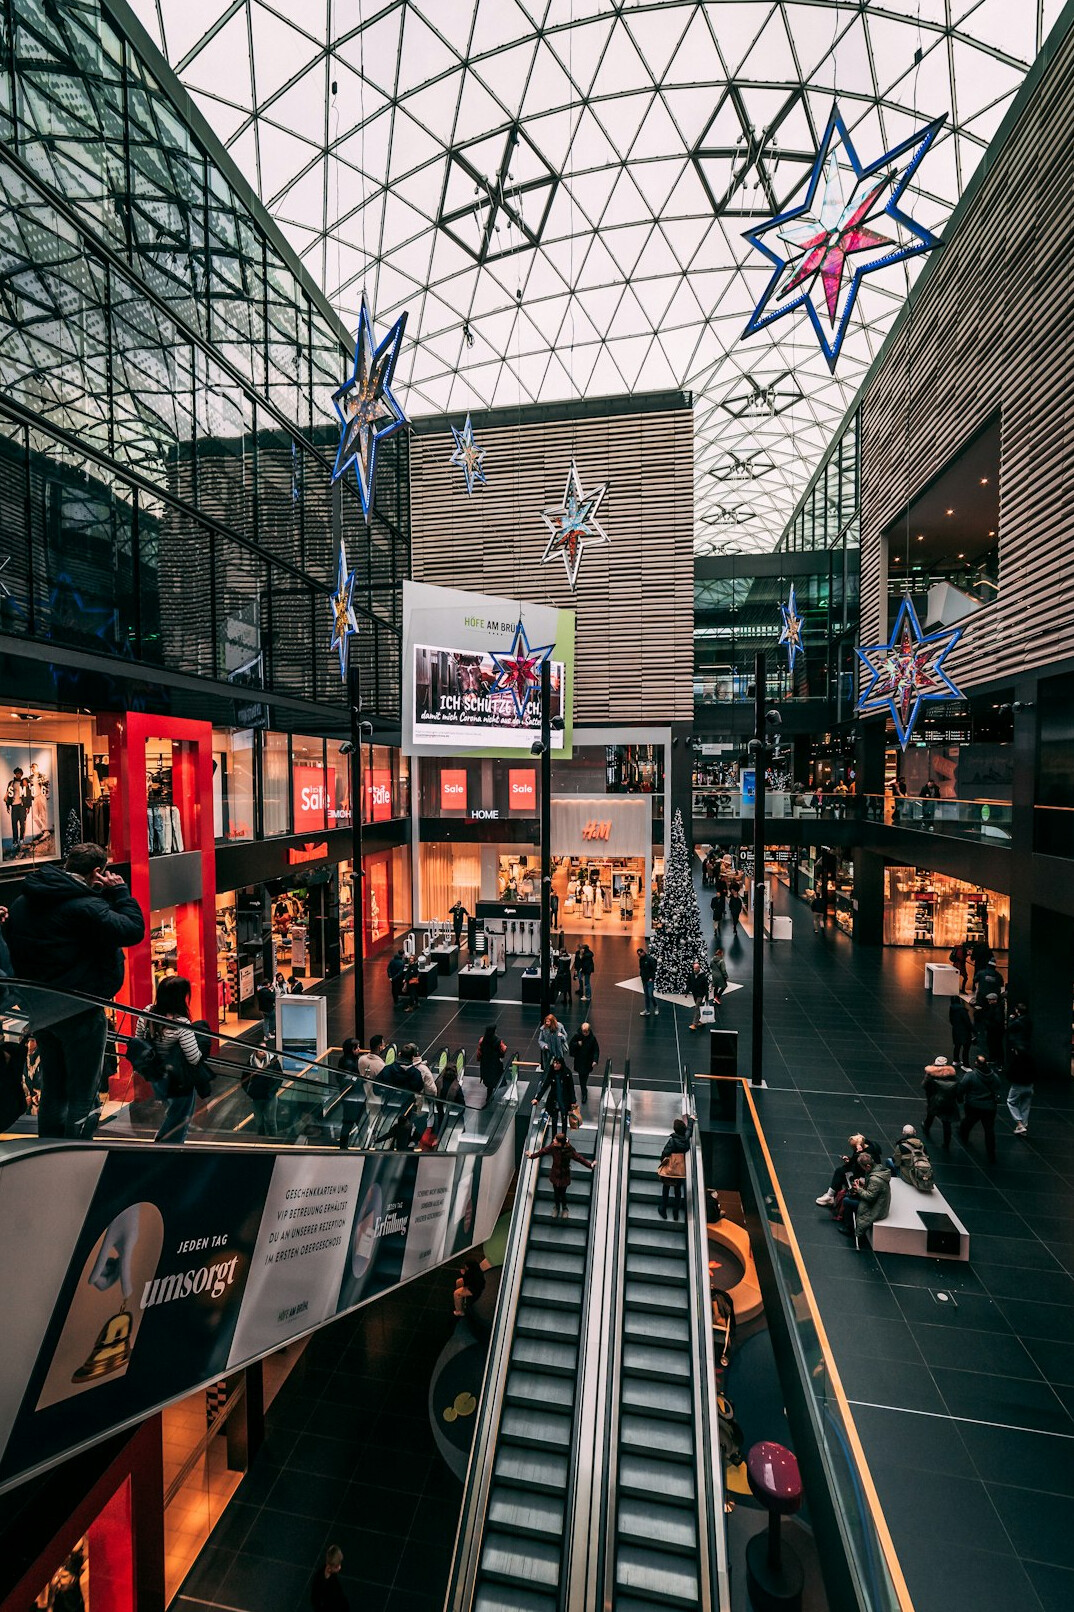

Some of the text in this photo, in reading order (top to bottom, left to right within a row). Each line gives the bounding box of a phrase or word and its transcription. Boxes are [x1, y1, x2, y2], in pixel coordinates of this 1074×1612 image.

[464, 615, 485, 628] HÖFE
[486, 620, 499, 631] AM
[440, 695, 461, 711] ICH
[464, 694, 511, 714] SCHÜTZE
[421, 709, 441, 720] damit
[442, 711, 458, 721] mich
[459, 711, 483, 722] Corona
[483, 713, 500, 723] nicht
[301, 786, 330, 811] Sale
[444, 784, 464, 793] Sale
[512, 784, 533, 793] Sale
[471, 809, 499, 820] HOME
[582, 818, 613, 841] H&M
[285, 1184, 349, 1200] GESCHENKKARTEN UND
[277, 1200, 348, 1220] VIP BETREUUNG ERHÄLTST
[268, 1218, 346, 1244] DU AN UNSERER REZEPTION
[373, 1212, 409, 1239] Erfüllung
[177, 1233, 228, 1254] JEDEN TAG
[265, 1236, 342, 1266] IM ERSTEN OBERGESCHOSS
[140, 1255, 239, 1310] umsorgt
